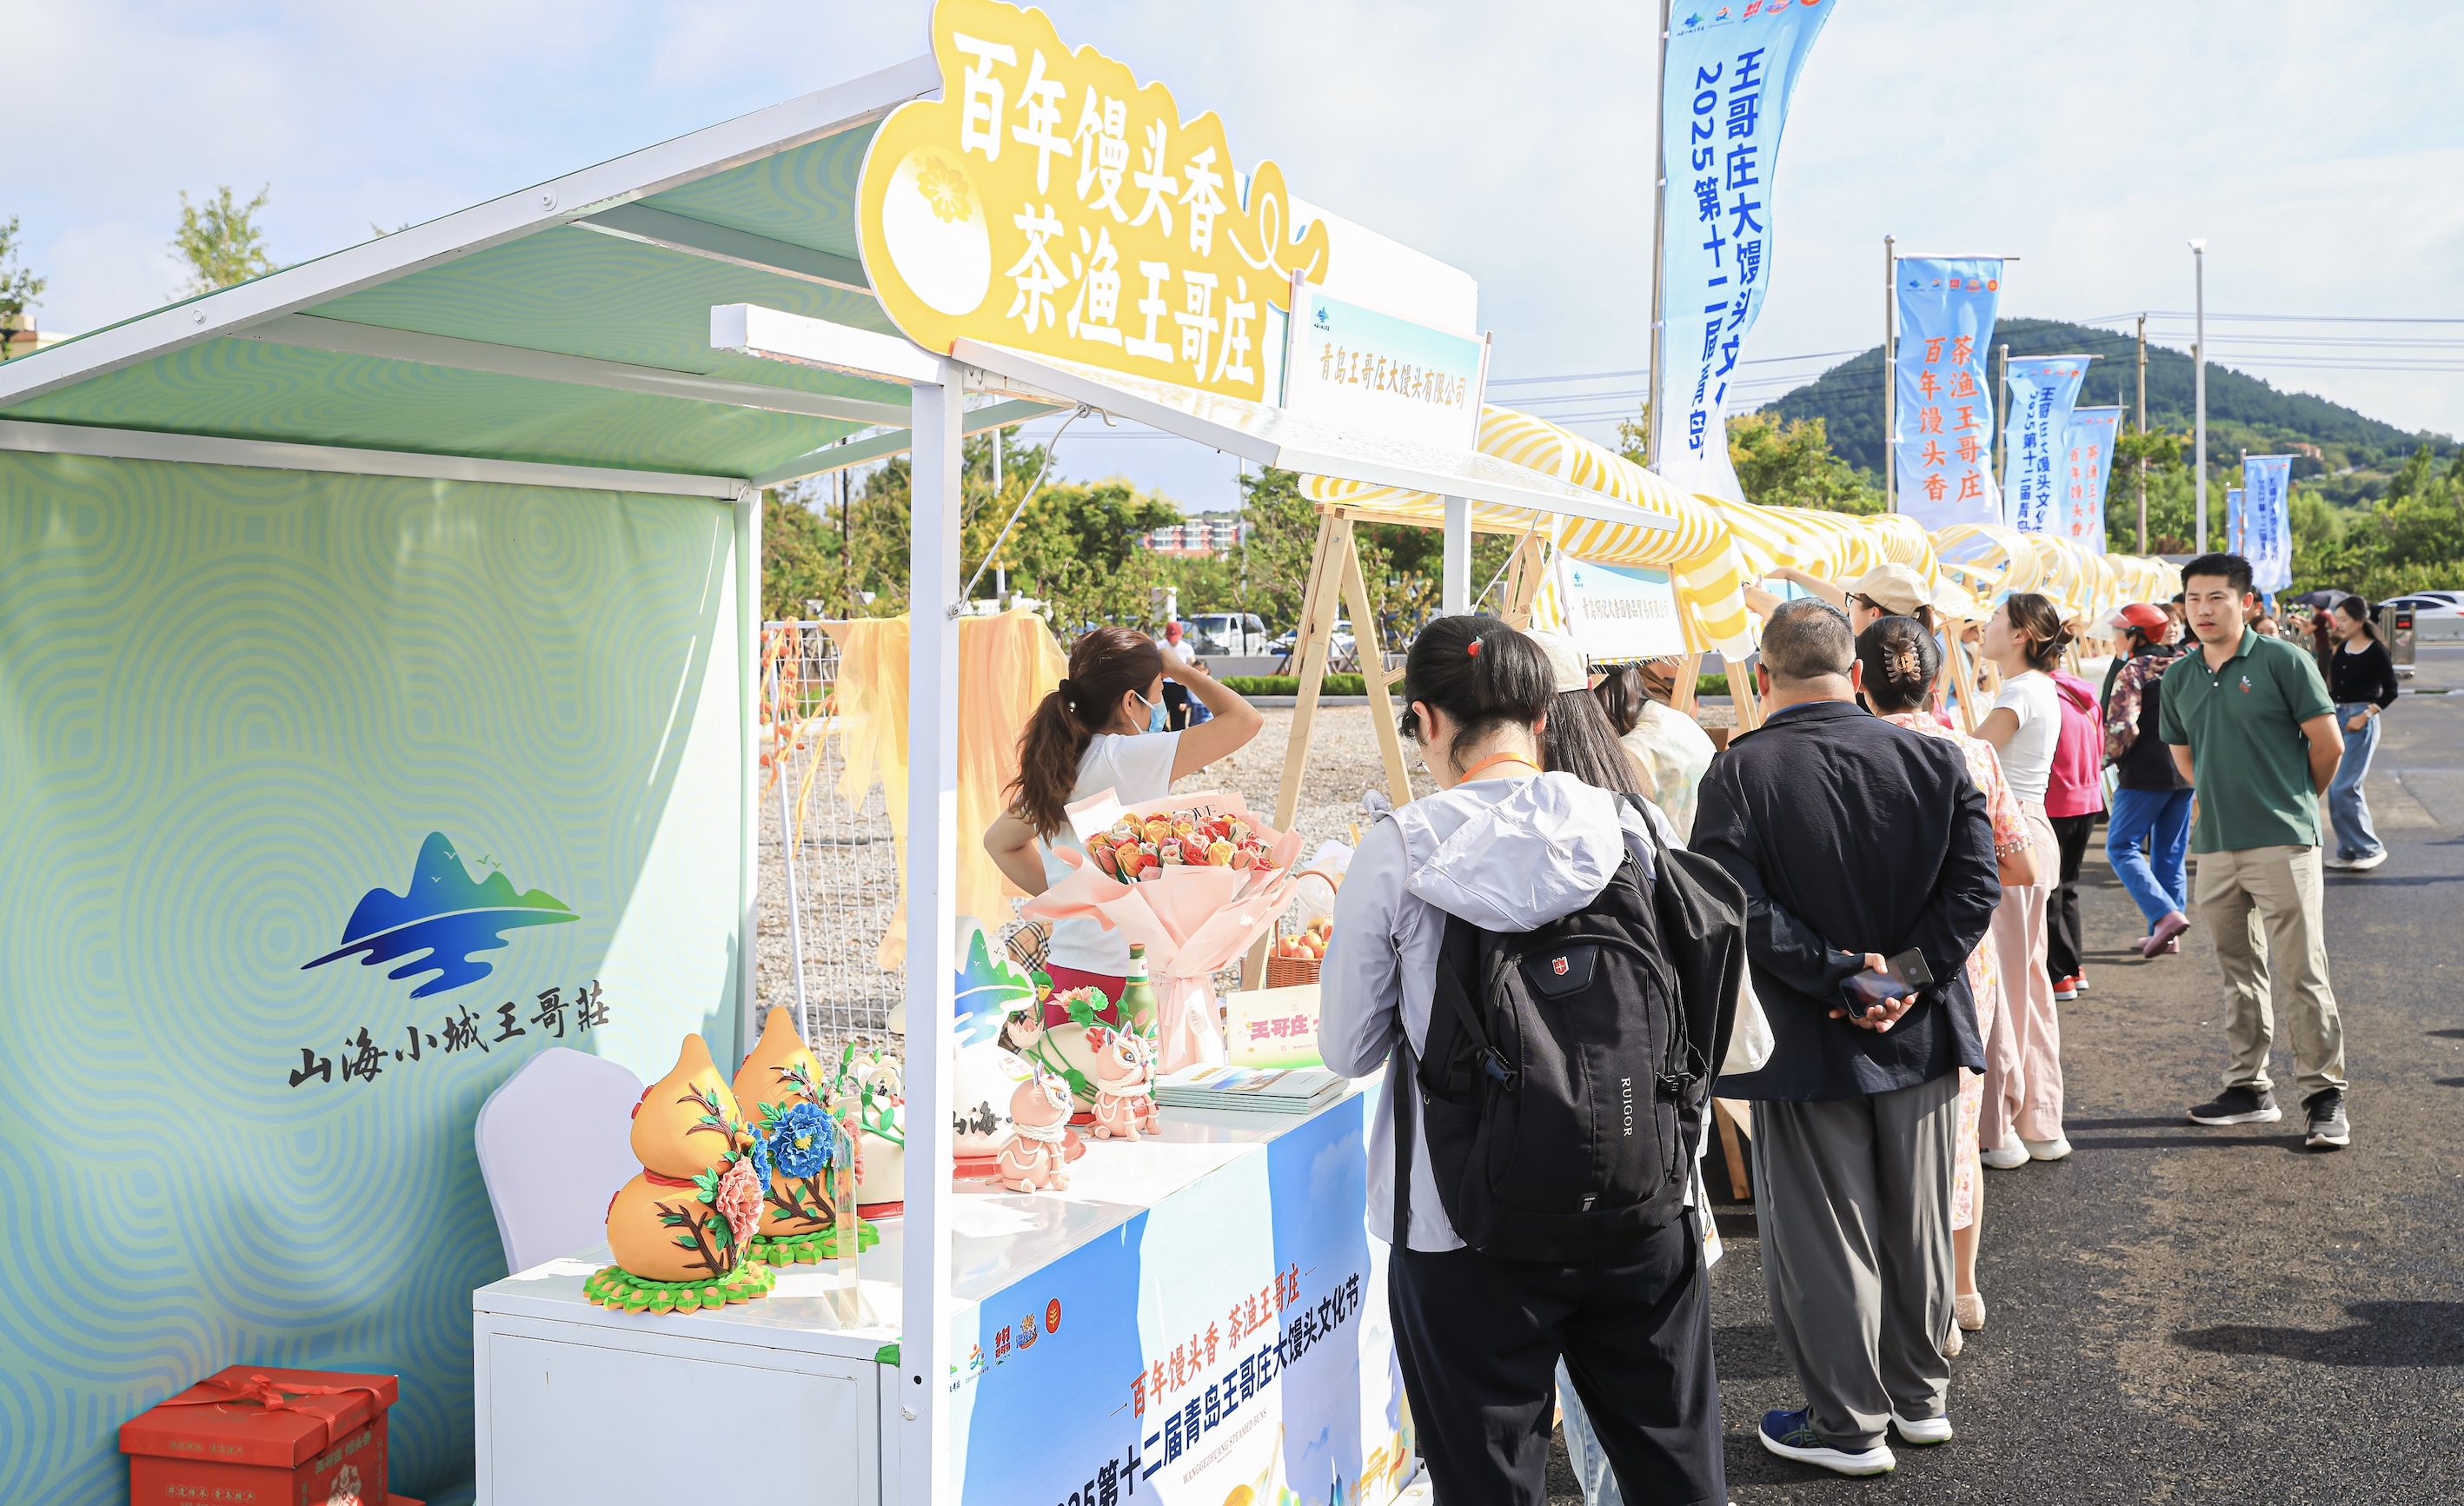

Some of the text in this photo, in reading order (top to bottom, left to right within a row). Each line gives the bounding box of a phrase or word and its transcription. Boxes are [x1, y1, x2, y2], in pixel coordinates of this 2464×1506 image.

[953, 31, 1226, 257] 百年馒头香
[1006, 202, 1257, 386] 茶渔王哥庄
[1320, 342, 1465, 410] 青岛王哥庄大馒头有限公司
[1918, 336, 1949, 501] 百年馒头香
[1949, 335, 1983, 503] 茶渔王哥庄
[1172, 804, 1216, 823] OVE
[1251, 1014, 1309, 1041] 王哥庄
[953, 1100, 1013, 1136] 山海
[1621, 1077, 1633, 1137] RUIGOR
[1057, 1272, 1359, 1506] 5第十二届青岛王哥庄大馒头文化节
[1131, 1263, 1300, 1418] 百年馒头香 茶渔王哥庄
[1183, 1440, 1228, 1484] WANGGEZHUANG
[1229, 1419, 1252, 1447] STEAMED
[1253, 1408, 1267, 1426] BUNS
